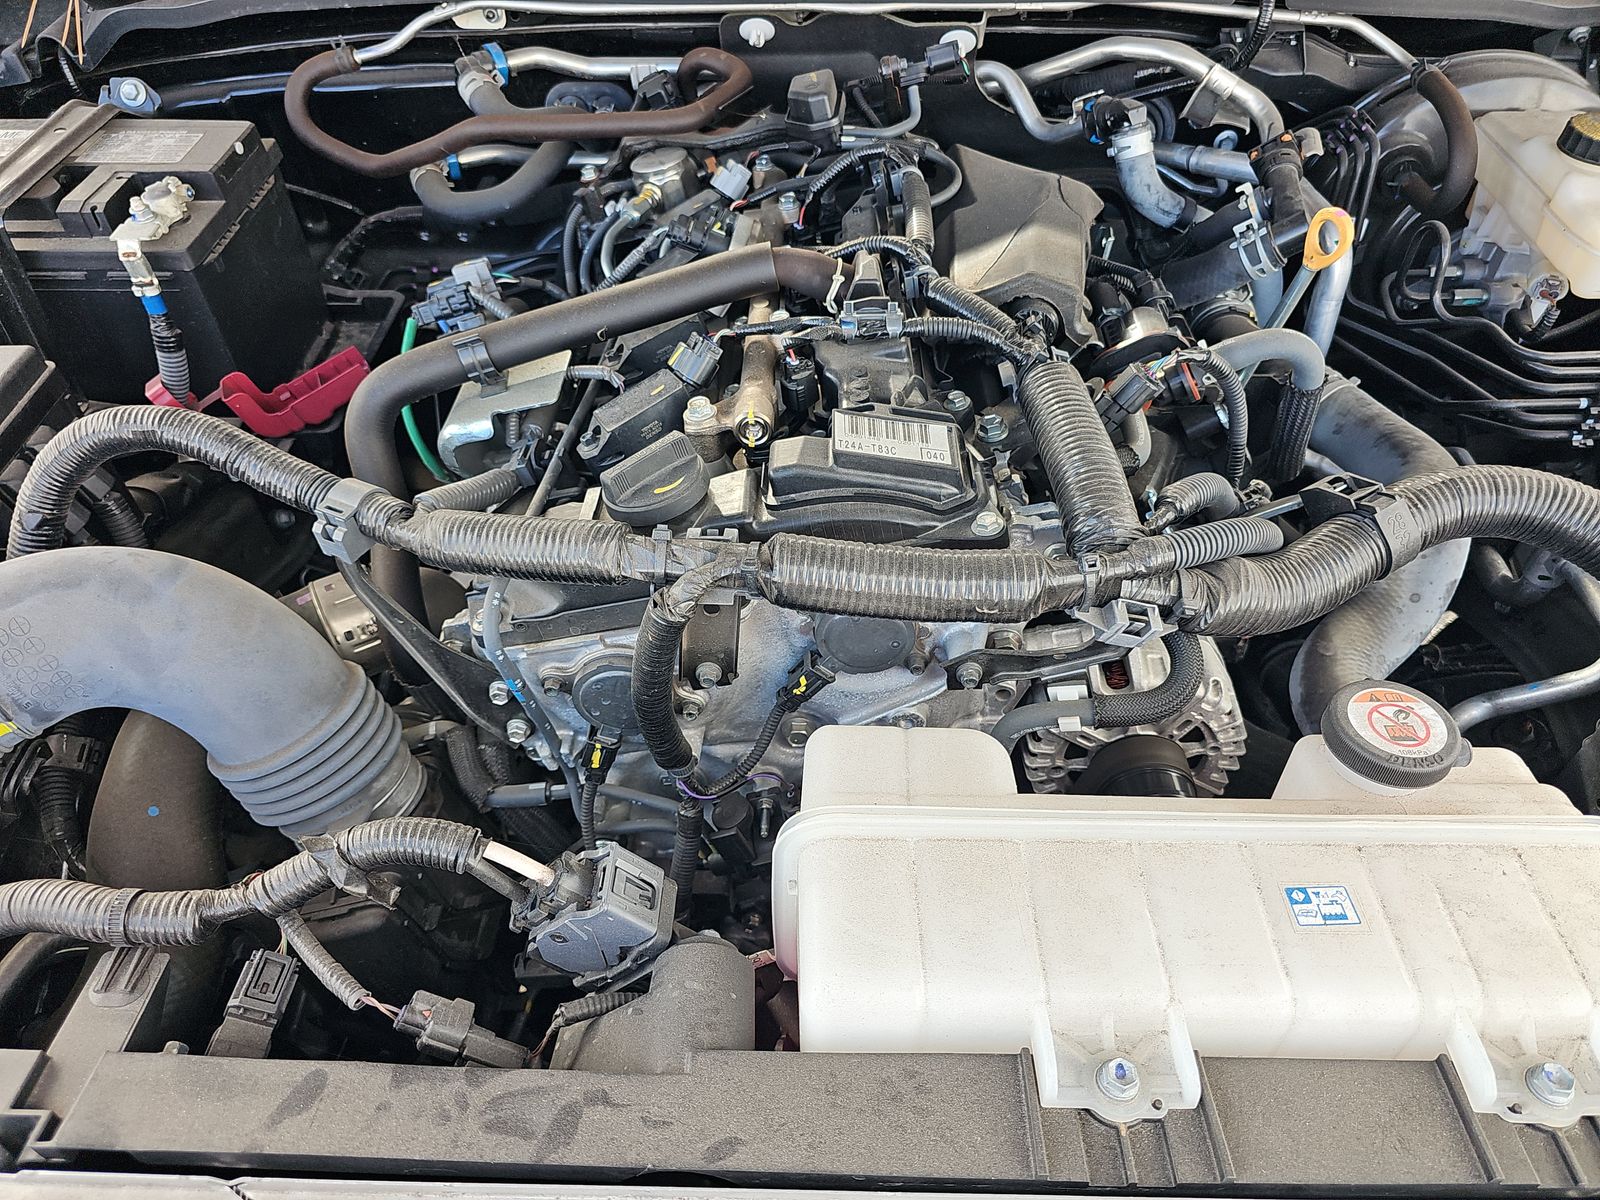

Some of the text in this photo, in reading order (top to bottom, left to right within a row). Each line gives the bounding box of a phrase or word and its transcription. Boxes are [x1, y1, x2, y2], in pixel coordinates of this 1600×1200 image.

[838, 439, 897, 456] T24A-T83C
[926, 451, 945, 461] 040
[1387, 754, 1445, 769] DENSO
